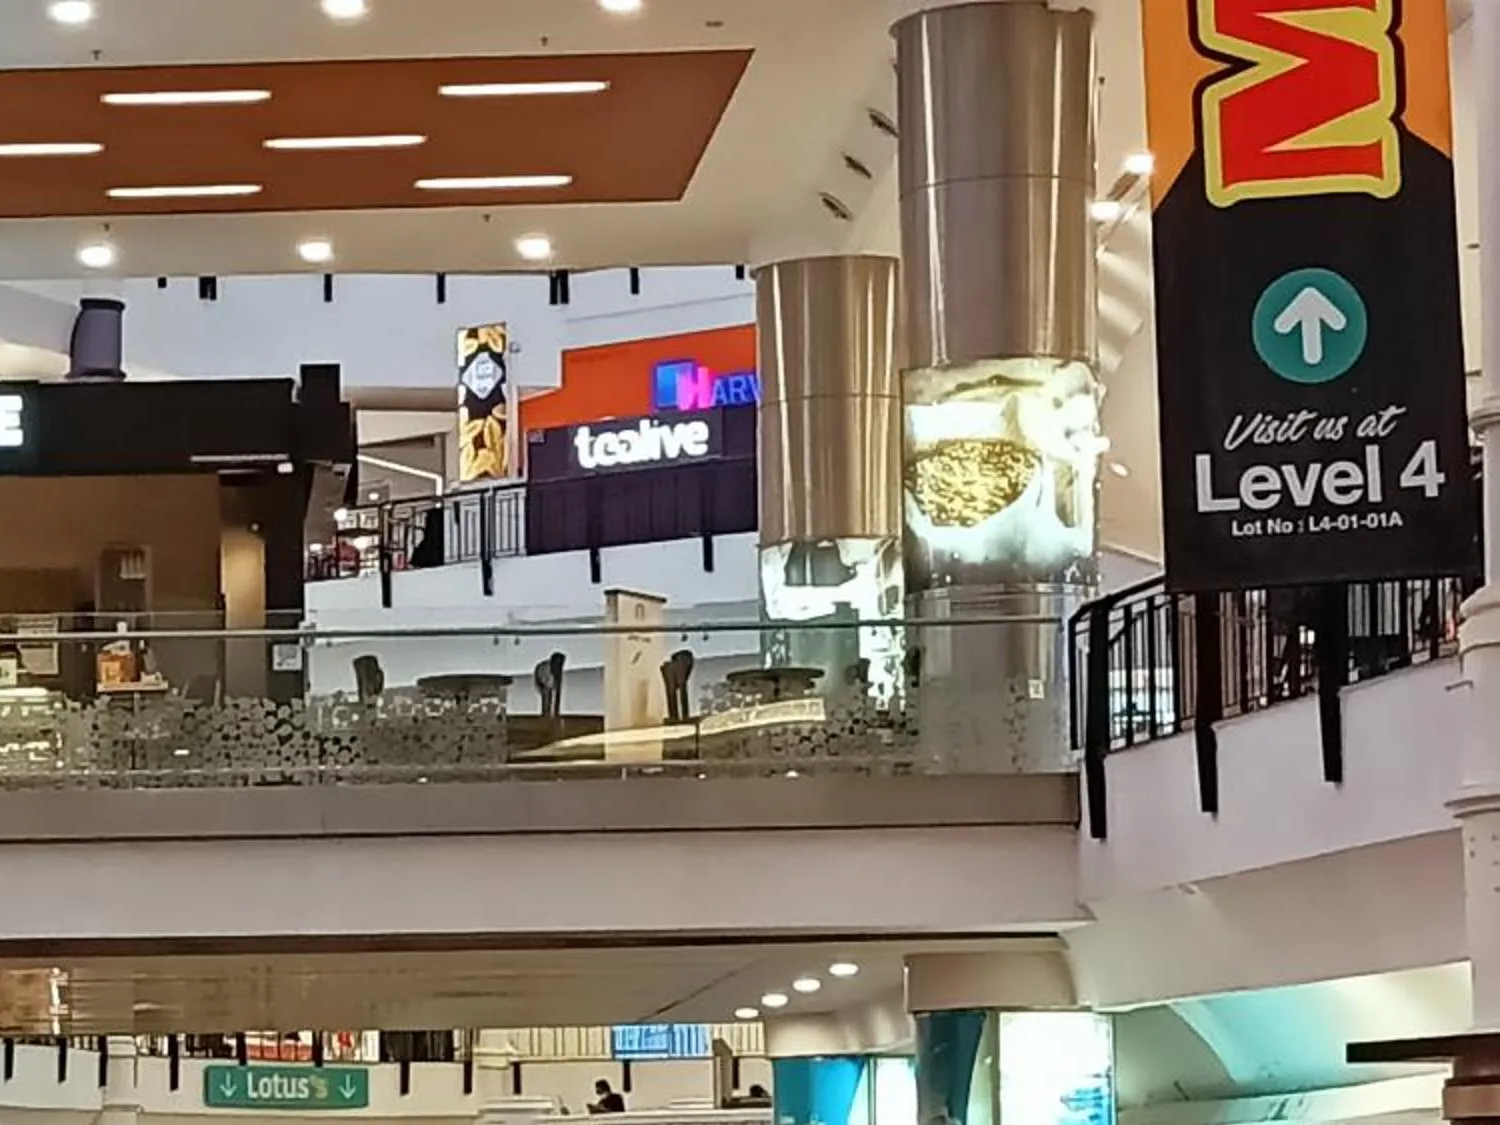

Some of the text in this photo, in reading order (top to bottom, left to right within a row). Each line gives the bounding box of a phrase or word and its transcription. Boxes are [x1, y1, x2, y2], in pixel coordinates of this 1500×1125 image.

[574, 418, 709, 470] tealive
[1224, 405, 1407, 450] Visit us at
[1195, 440, 1446, 513] Level 4
[1232, 519, 1262, 537] Lot
[1267, 517, 1294, 534] No
[1309, 511, 1403, 532] L4-01-01A
